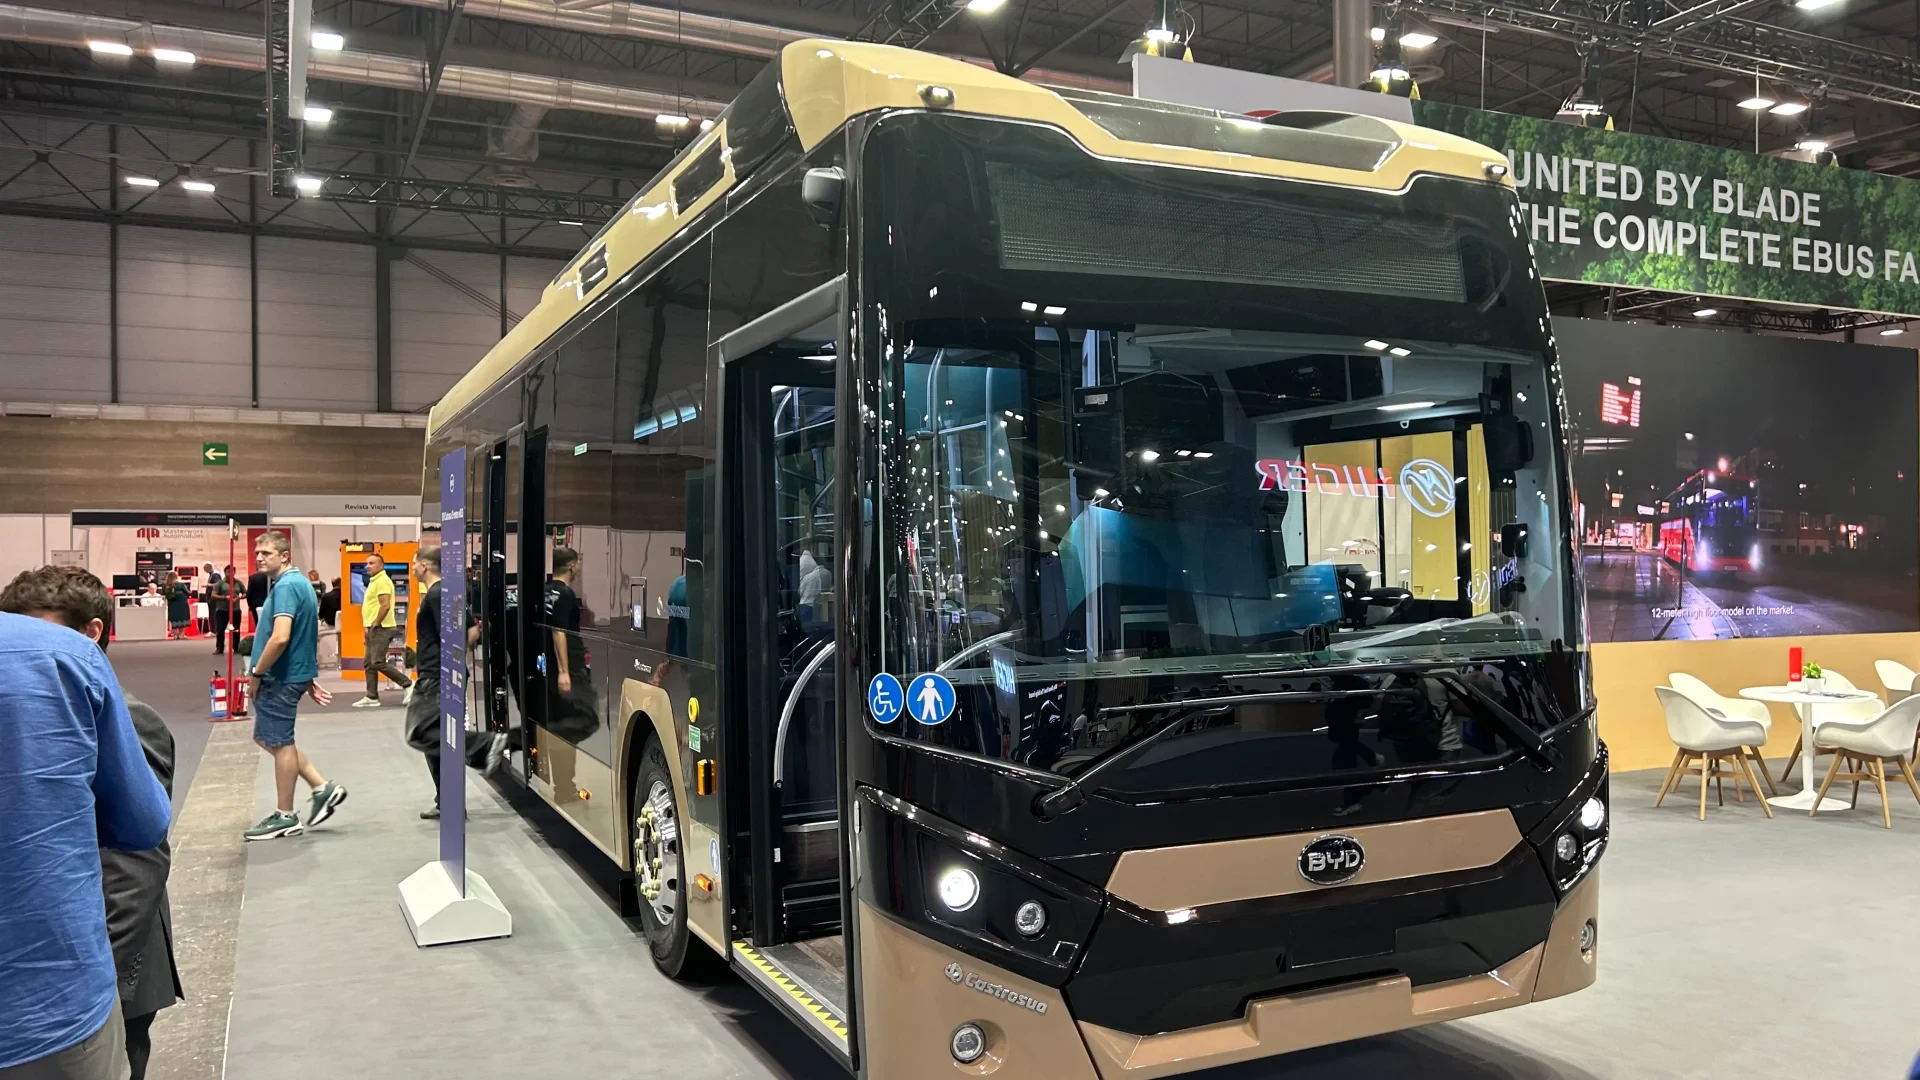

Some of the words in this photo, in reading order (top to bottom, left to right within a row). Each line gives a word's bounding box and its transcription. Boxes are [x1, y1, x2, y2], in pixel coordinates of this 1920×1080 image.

[1508, 149, 1643, 202] UNITED
[1656, 169, 1702, 209] BY
[1713, 179, 1821, 227] BLADE
[1519, 202, 1581, 245] HE
[1593, 211, 1782, 269] COMPLETE
[1793, 237, 1874, 279] EBUS
[1885, 249, 1920, 284] FA
[370, 503, 396, 511] Viajeros
[1651, 607, 1684, 618] 12-meter
[1722, 606, 1744, 616] model
[1745, 607, 1755, 615] on
[1756, 606, 1768, 615] the
[1769, 605, 1795, 615] market.
[1307, 849, 1361, 871] BYD
[965, 972, 1048, 1014] Castrosua
